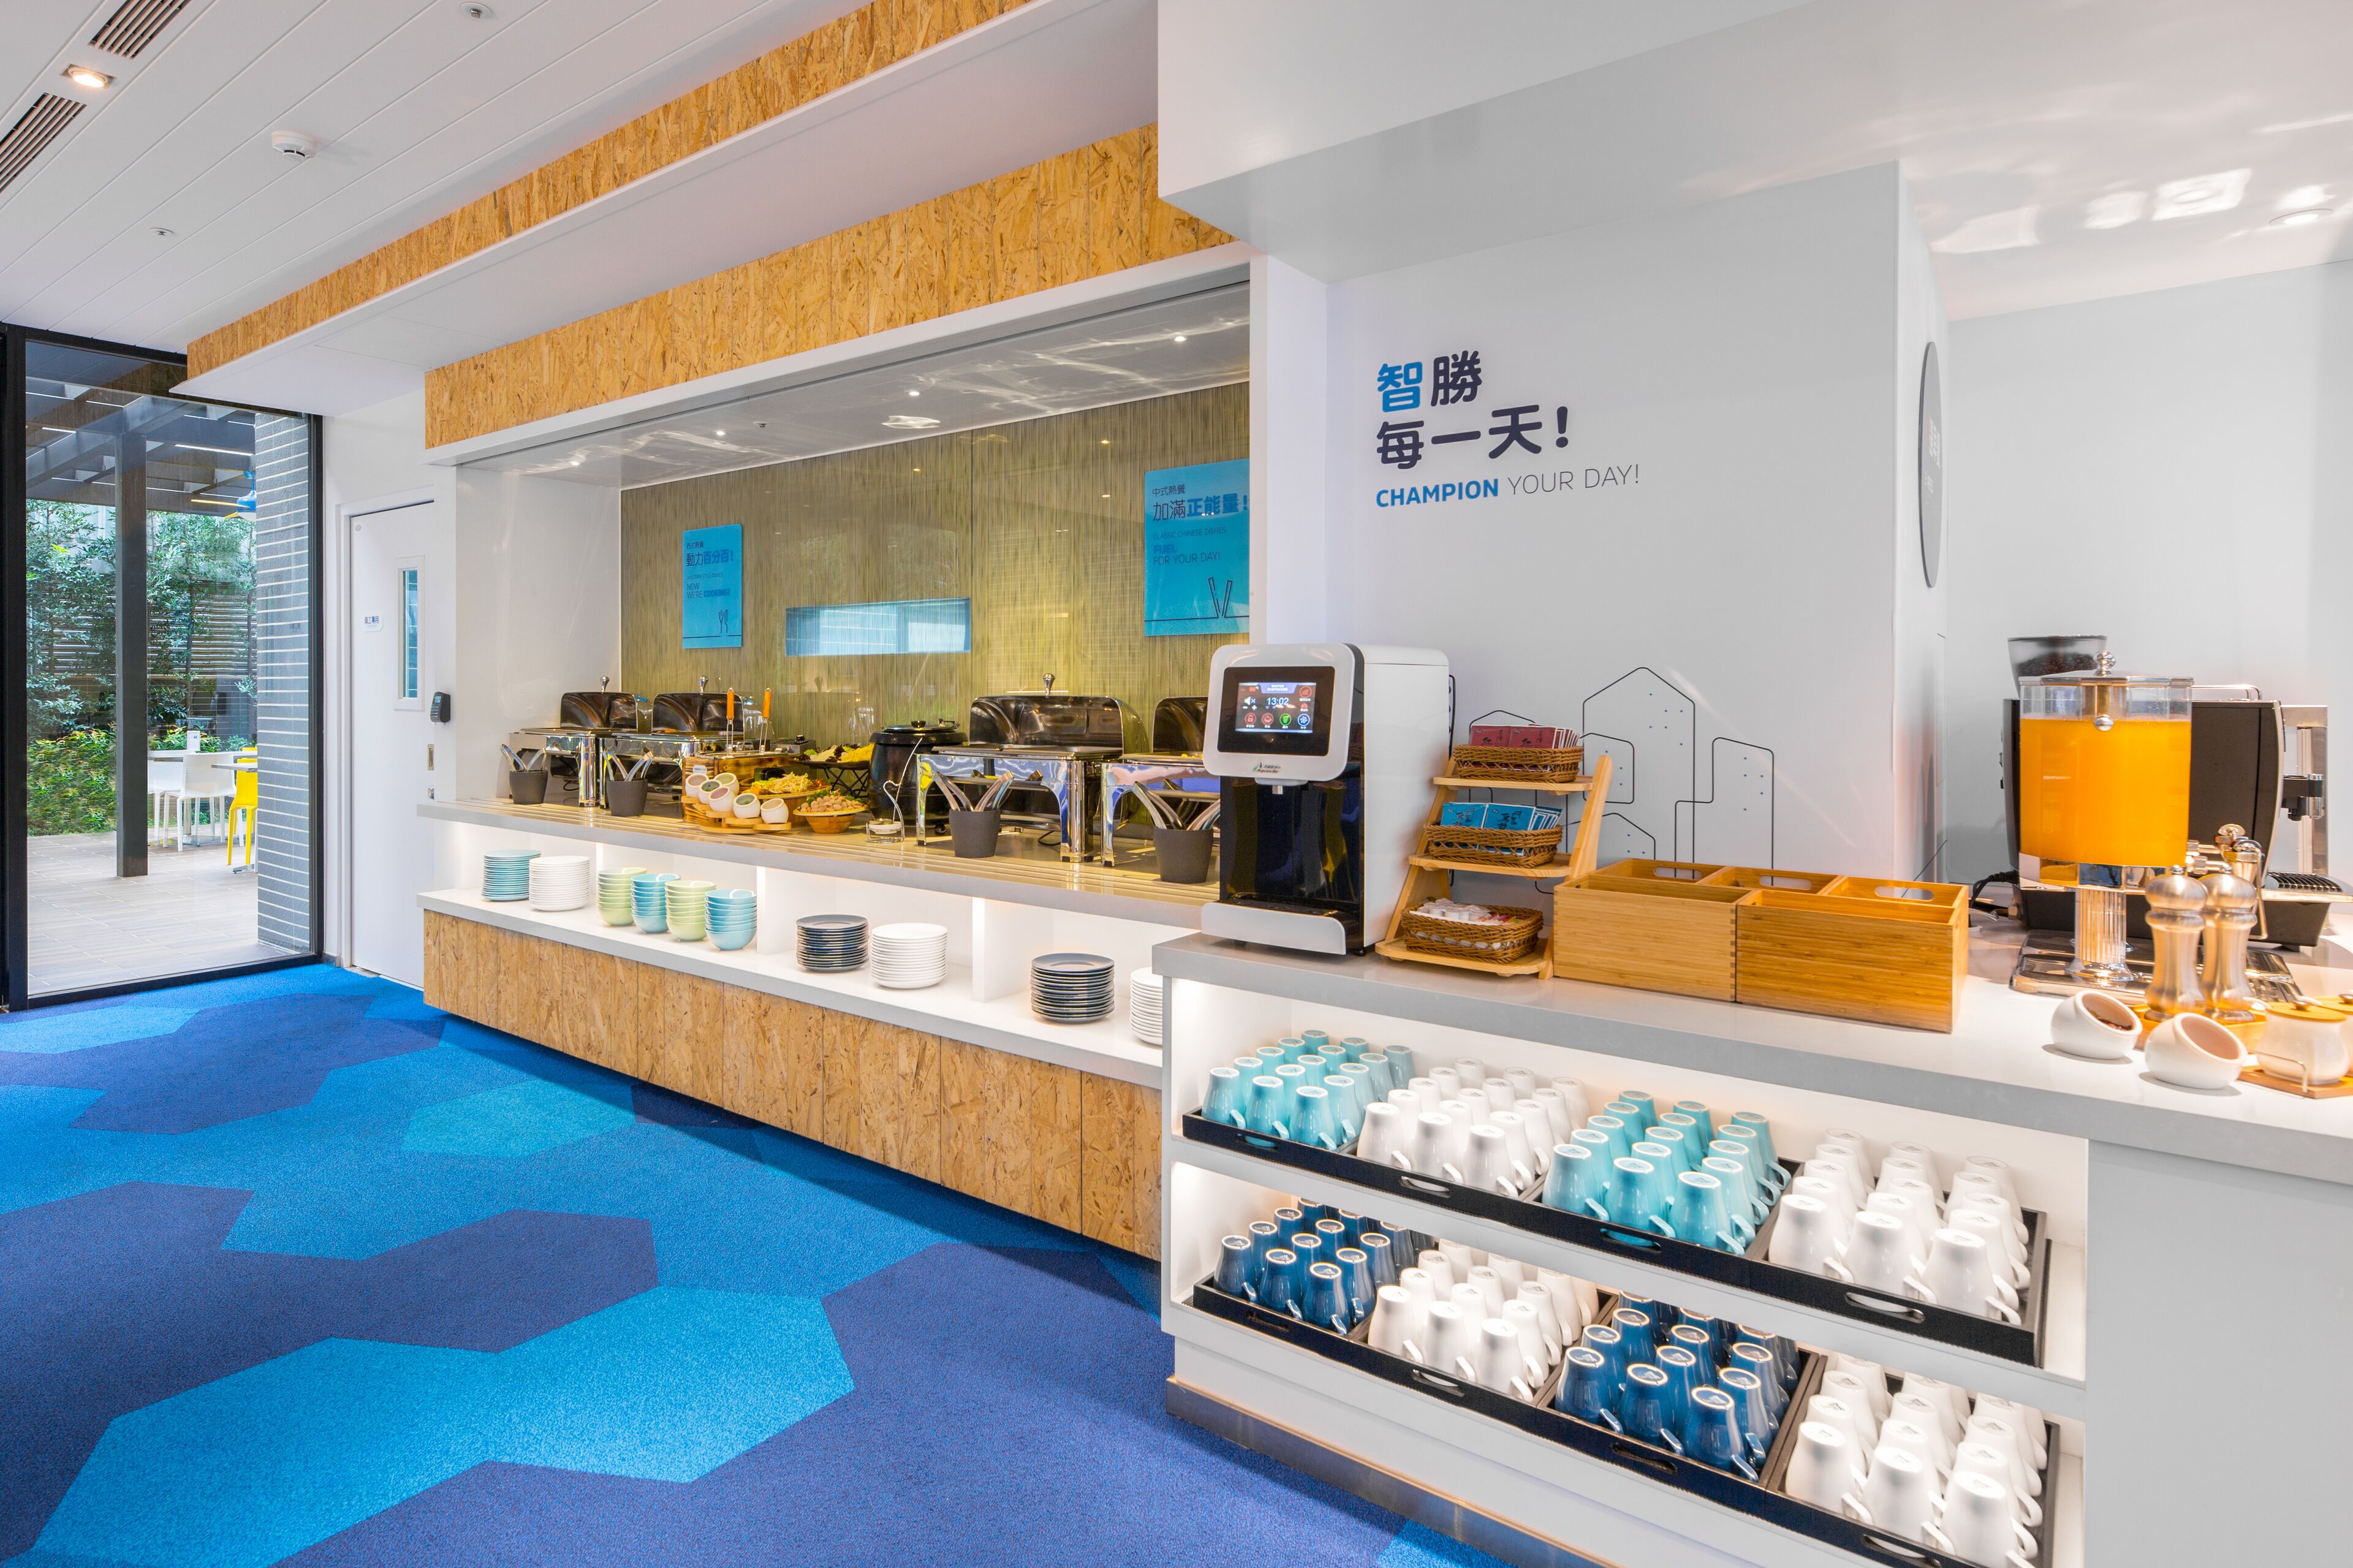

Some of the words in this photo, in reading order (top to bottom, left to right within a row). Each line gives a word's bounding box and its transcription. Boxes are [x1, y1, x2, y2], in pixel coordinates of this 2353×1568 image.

[1376, 350, 1483, 413] 智勝
[1376, 404, 1569, 470] 每一天!
[1152, 484, 1186, 497] 中式熱餐
[1376, 478, 1499, 507] CHAMPION
[1507, 471, 1574, 496] YOUR
[1584, 464, 1640, 489] DAY!
[1152, 493, 1249, 521] 加滿正能量!
[1153, 531, 1176, 540] CLASSIC
[1177, 528, 1203, 538] CHINESE
[1204, 526, 1227, 536] DISHES
[686, 548, 734, 567] 動力百分百!
[1153, 543, 1178, 555] FUEL
[1153, 554, 1170, 566] FOR
[1172, 553, 1198, 564] YOUR
[1200, 551, 1221, 562] DAY!
[703, 588, 730, 597] COOKING!
